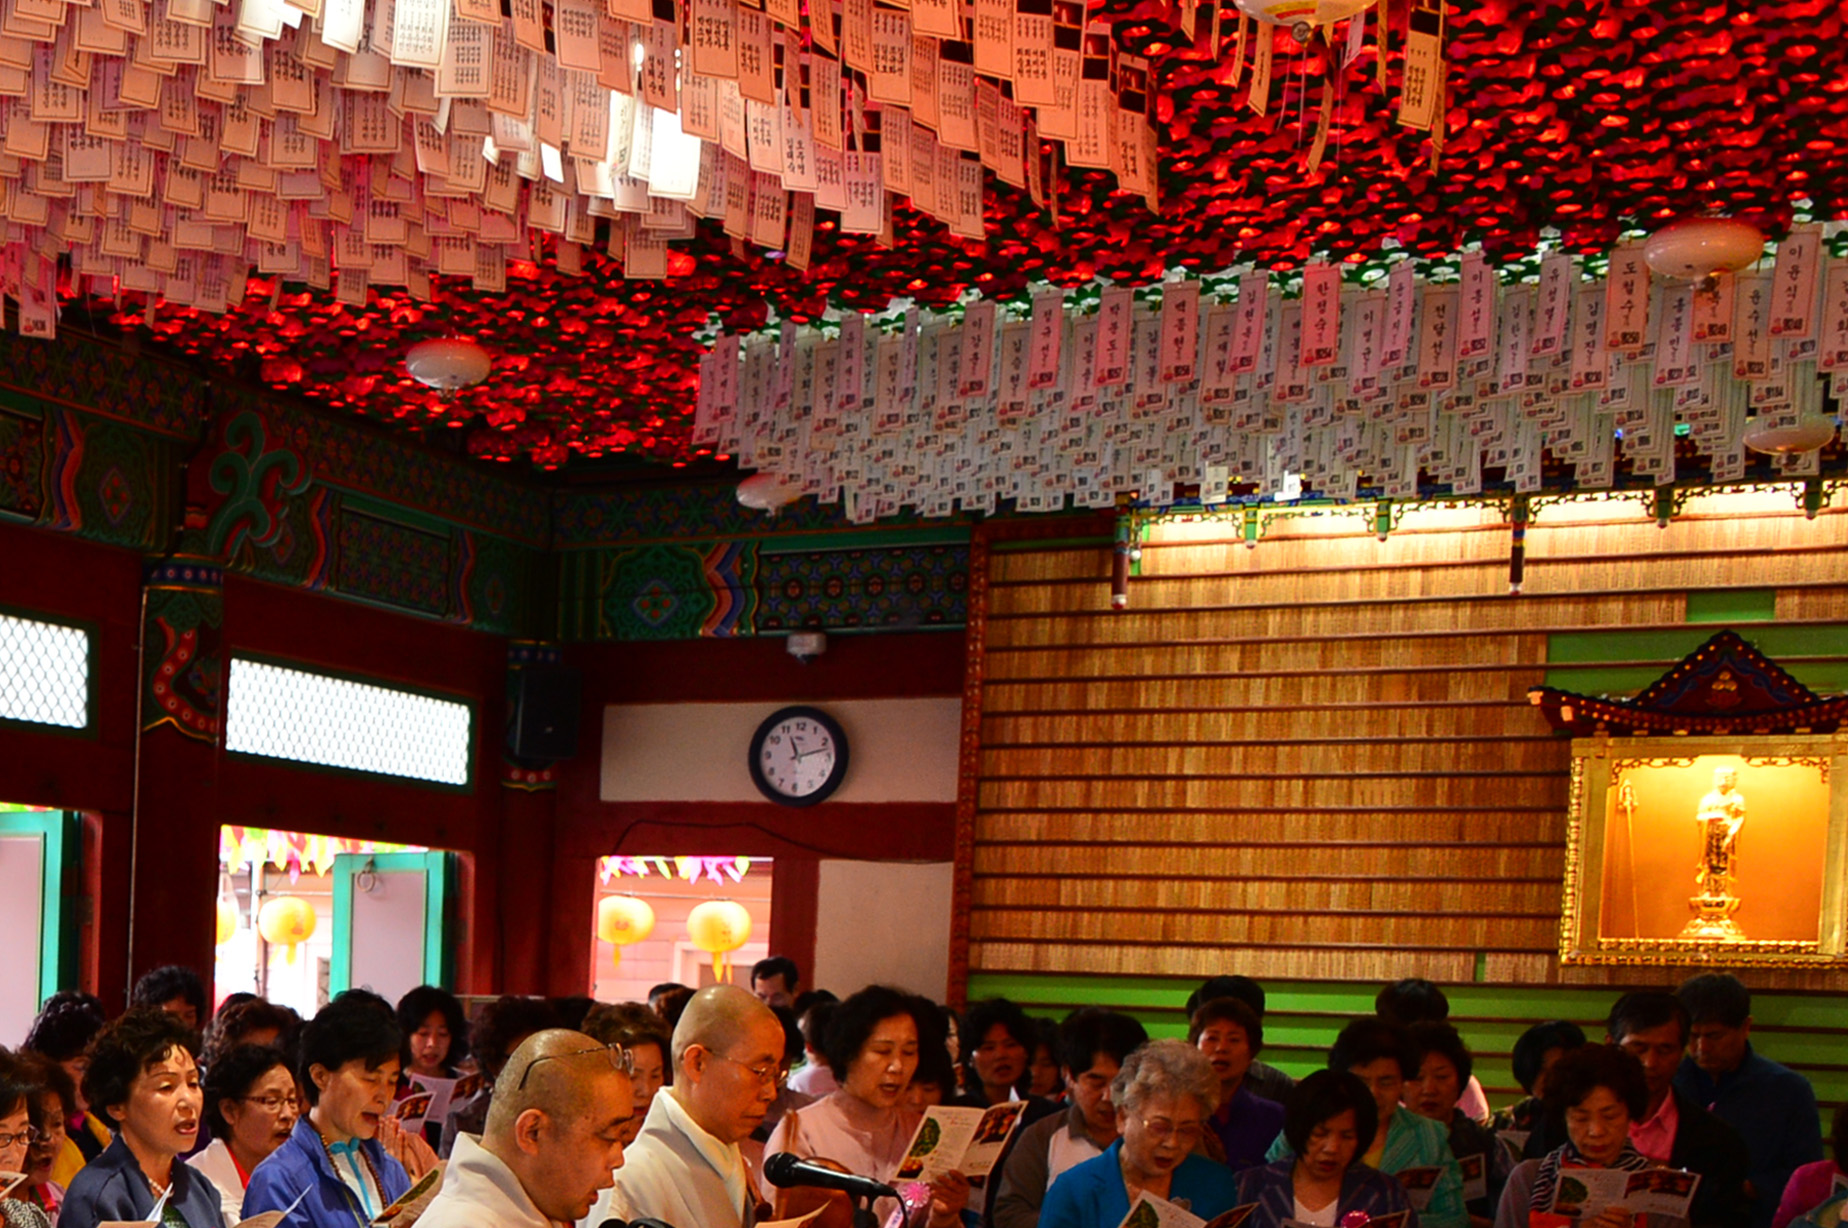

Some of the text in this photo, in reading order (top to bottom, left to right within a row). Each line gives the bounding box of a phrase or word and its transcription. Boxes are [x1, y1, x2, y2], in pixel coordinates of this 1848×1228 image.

[782, 725, 791, 734] 11
[796, 722, 807, 731] 12
[813, 726, 817, 734] 1
[770, 736, 781, 745] 10
[821, 737, 829, 746] 2
[765, 751, 772, 759] 9
[768, 767, 774, 776] 8
[778, 778, 784, 787] 7
[791, 784, 798, 793] 6
